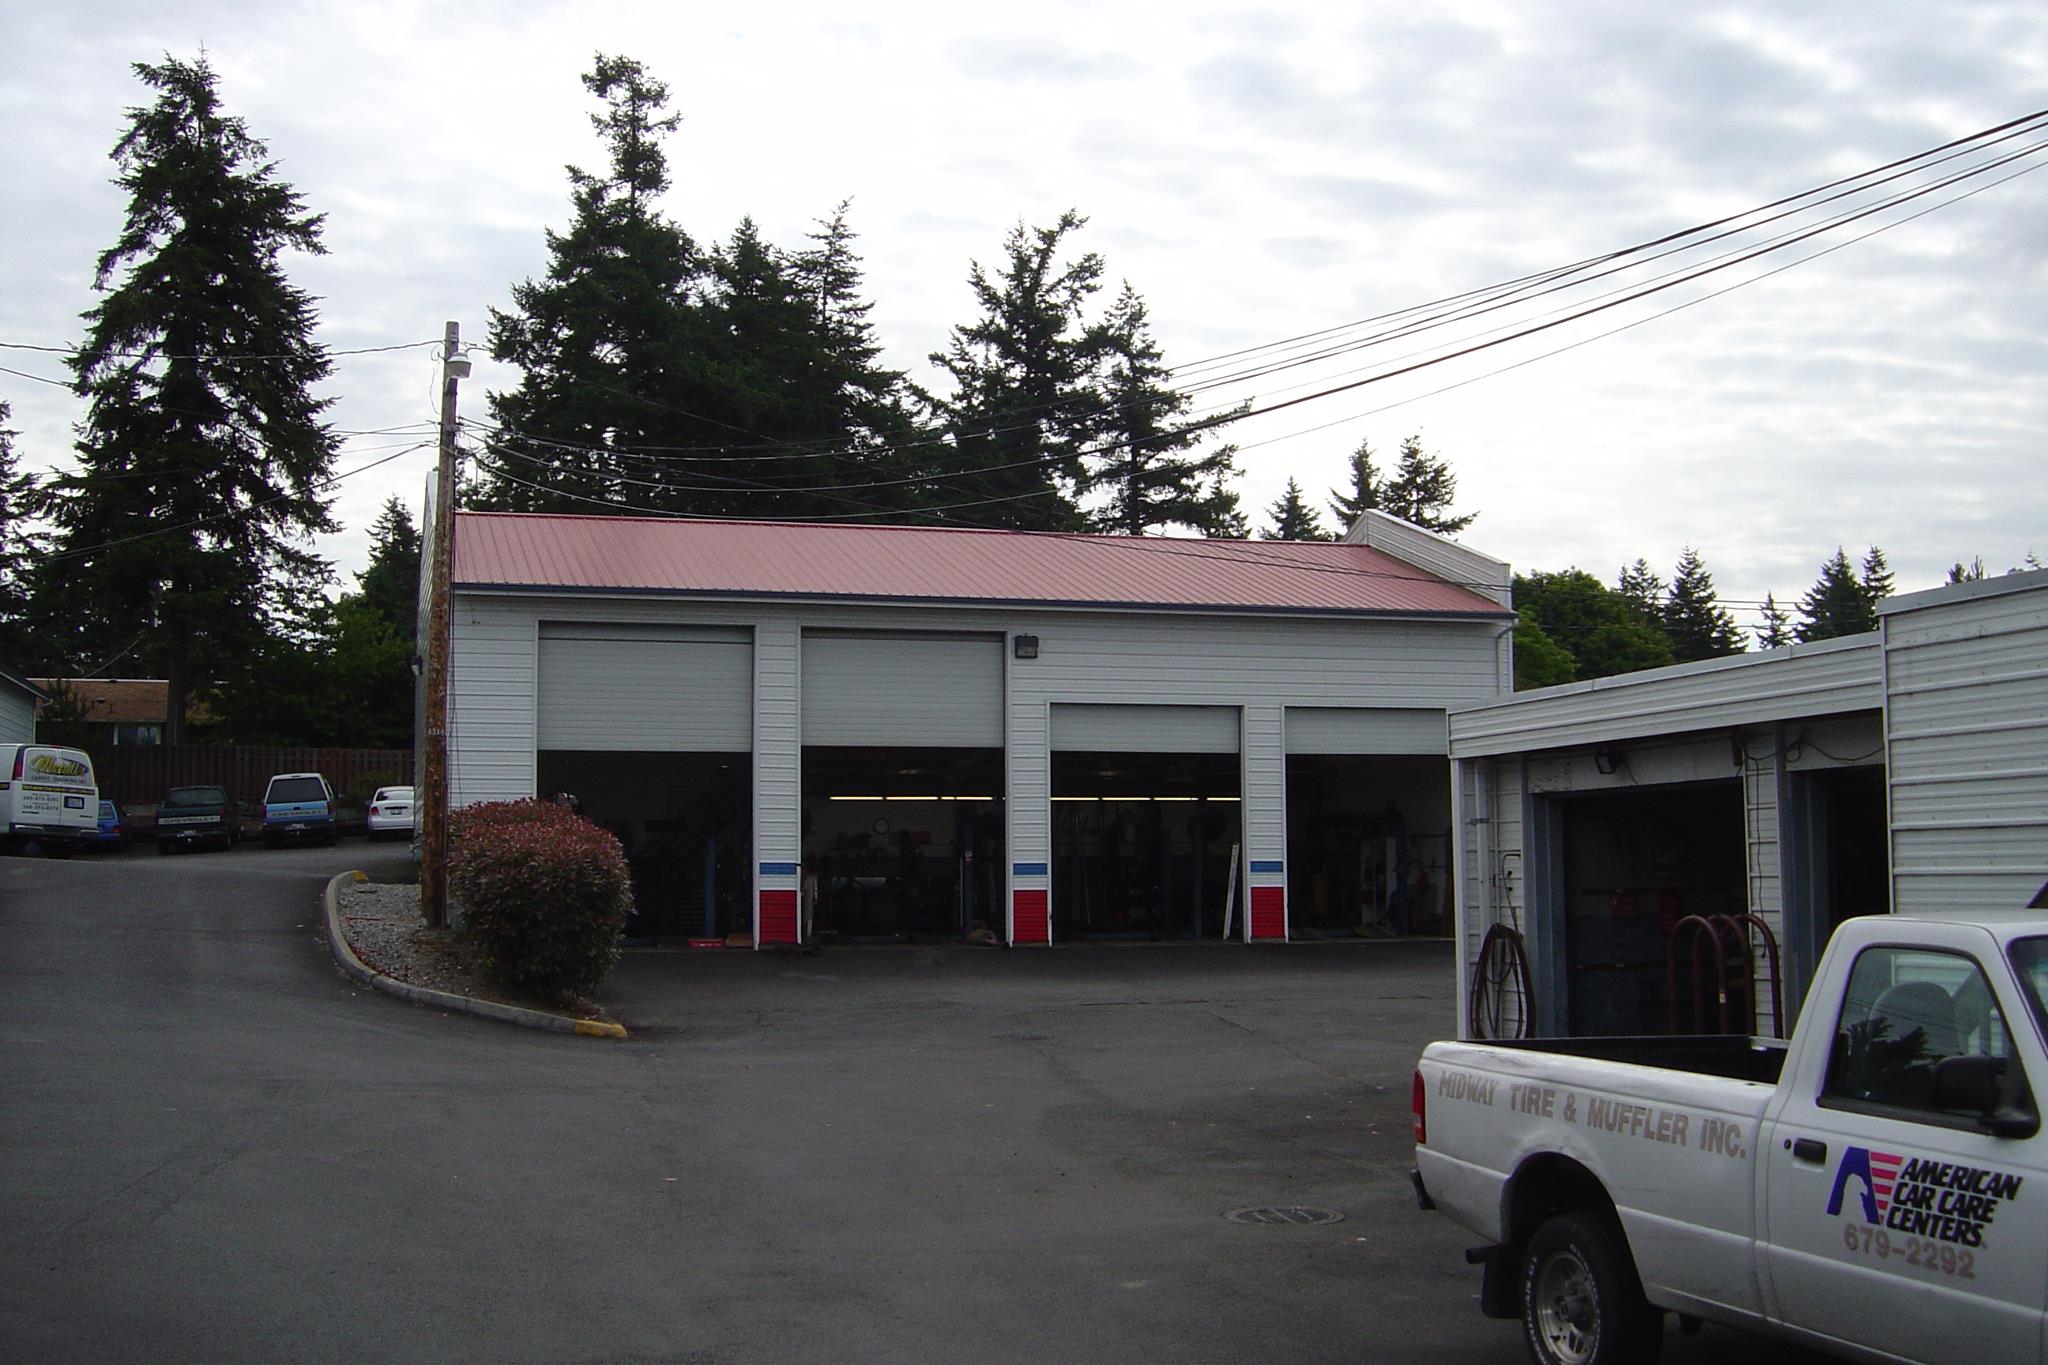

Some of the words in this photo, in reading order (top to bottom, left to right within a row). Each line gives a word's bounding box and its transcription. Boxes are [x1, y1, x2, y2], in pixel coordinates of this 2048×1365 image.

[1438, 1070, 1499, 1106] MIDWAY
[1510, 1083, 1556, 1118] TIRE
[1564, 1093, 1577, 1123] &
[1587, 1098, 1689, 1146] MUFFLER
[1700, 1118, 1746, 1158] INC.
[1900, 1157, 2023, 1200] AMERICAN
[1893, 1181, 1936, 1211] CAR
[1937, 1189, 1998, 1223] CARE
[1886, 1205, 1984, 1248] CENTERS
[1844, 1223, 1975, 1279] 679-2292
